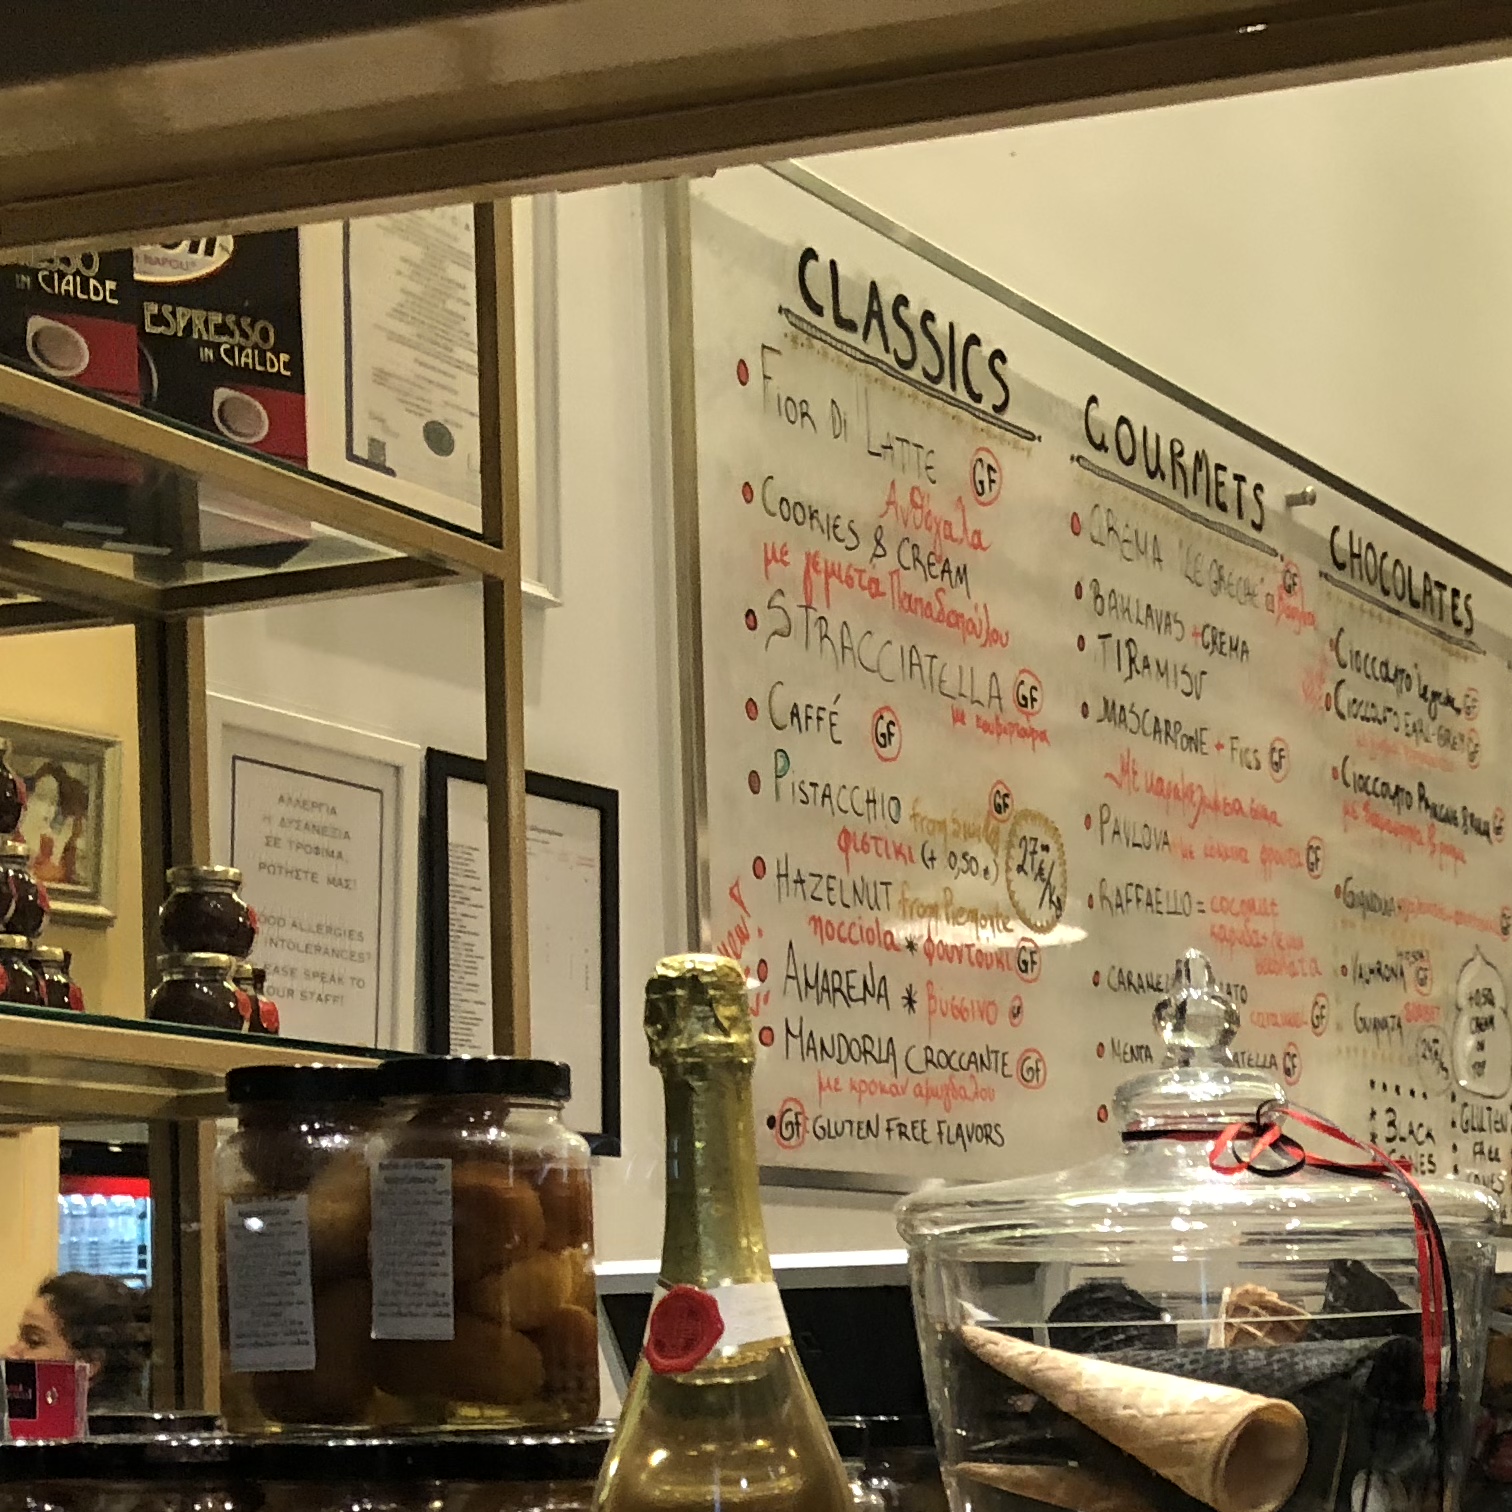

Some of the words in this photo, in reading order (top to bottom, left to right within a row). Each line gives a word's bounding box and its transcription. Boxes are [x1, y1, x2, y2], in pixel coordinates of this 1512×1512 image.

[38, 270, 119, 304] CIALDE
[143, 301, 275, 349] ESPRESSO
[798, 247, 1012, 413] CLASSICS
[200, 346, 214, 363] IN
[220, 344, 292, 377] CIALDE
[866, 388, 938, 486] LATTE
[1084, 394, 1265, 532] GOURMETS
[761, 476, 861, 552] COOKIES
[897, 537, 971, 600] CREAM
[1330, 525, 1475, 636] CHOCOLATES
[765, 588, 1003, 713] STRACCIATELLA
[875, 716, 897, 749] GF
[278, 794, 338, 816] ΑΛΛΕΡΓΙΑ
[265, 836, 282, 849] ΣΕ
[280, 817, 351, 841] ΔΥΣΑΝΕΞΙΑ
[1099, 803, 1171, 851] PAVLOVA
[259, 861, 319, 885] ΡΩΤΗΣΤΕ
[776, 853, 893, 913] HAZELNUT
[1099, 877, 1192, 917] RAFFAELLO
[256, 914, 287, 928] OOD
[291, 920, 365, 943] ALLERGIES
[264, 964, 297, 978] EASE
[304, 969, 345, 986] SPEAK
[350, 976, 366, 989] TO
[783, 940, 890, 1010] AMARENA
[905, 1044, 1013, 1078] CROCCANTE
[1111, 1037, 1153, 1064] MENTA
[812, 1114, 880, 1141] GLUTEN
[887, 1117, 929, 1145] FREE
[938, 1121, 1005, 1153] FLAVORS
[1385, 1107, 1436, 1146] BLACK
